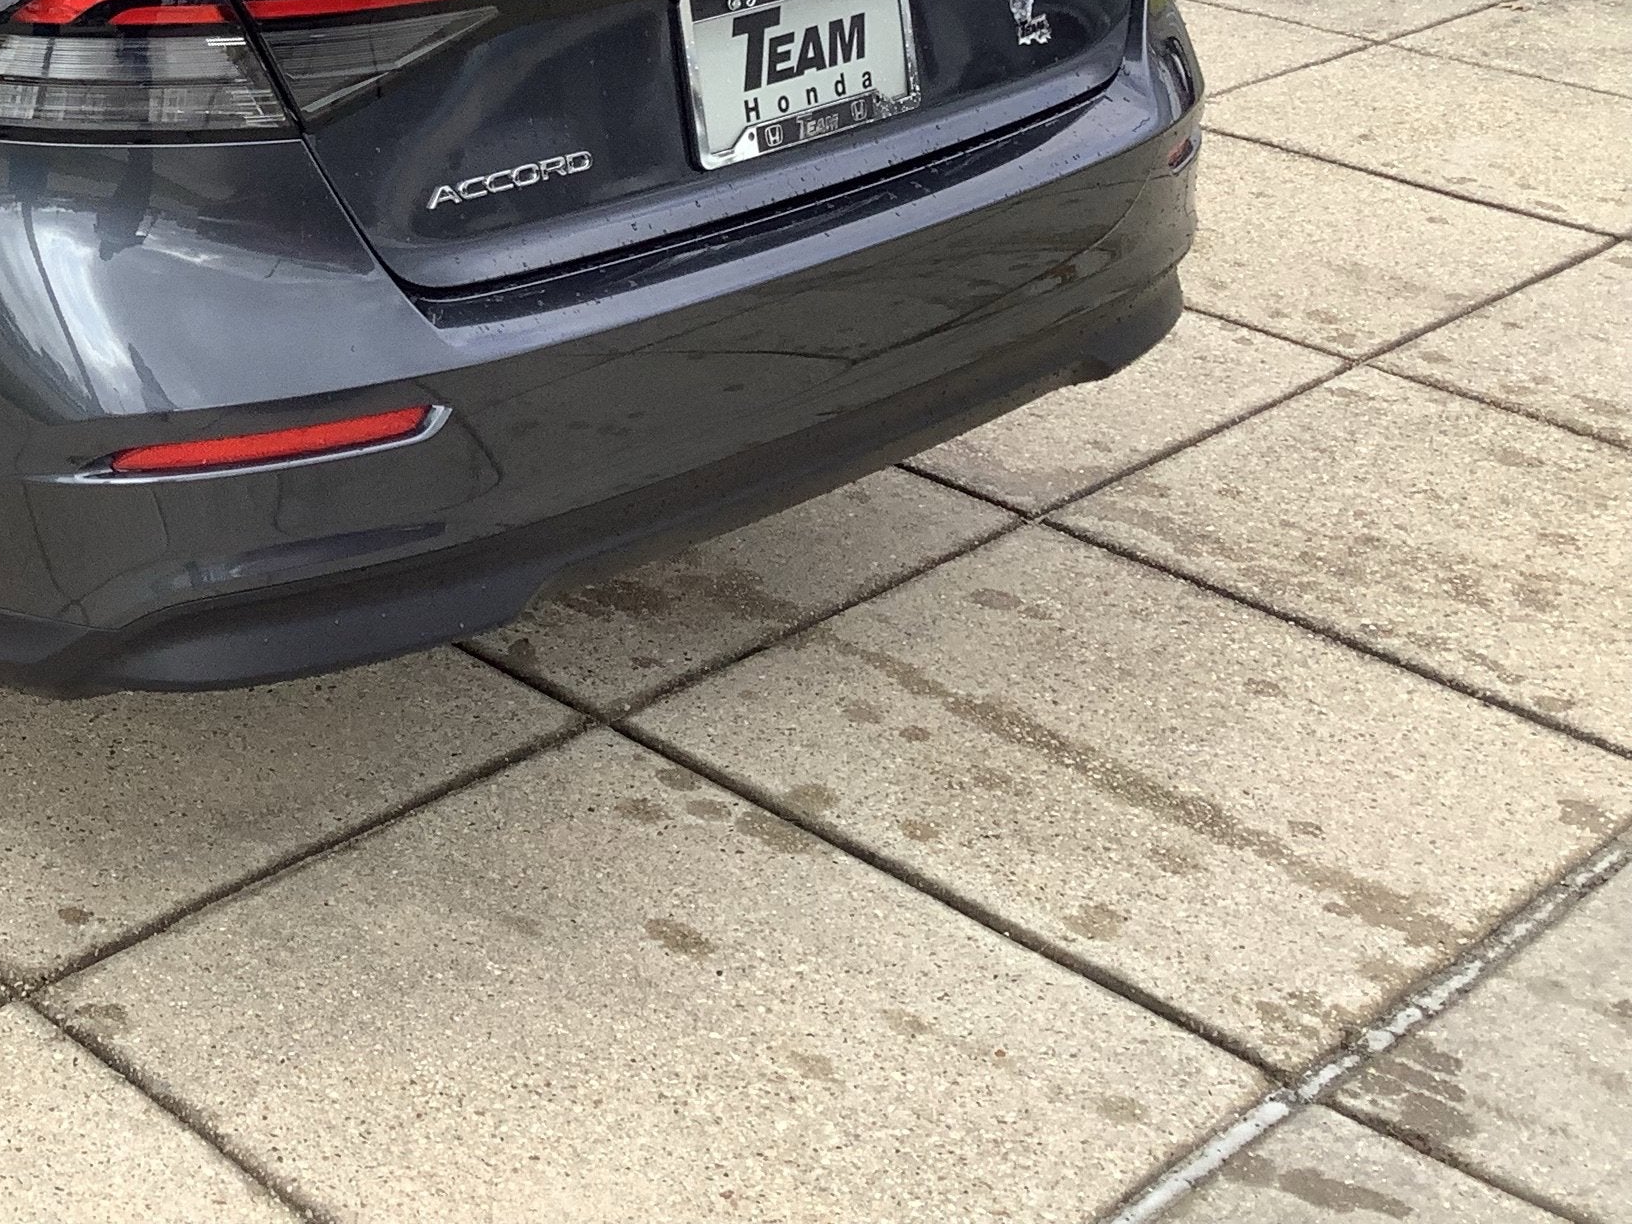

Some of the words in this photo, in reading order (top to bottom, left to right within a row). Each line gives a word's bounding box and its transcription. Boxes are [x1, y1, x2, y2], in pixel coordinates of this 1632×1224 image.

[731, 6, 866, 93] TEAM
[744, 70, 873, 123] Honda
[796, 112, 839, 140] TEAM
[426, 150, 593, 210] ACCORD
